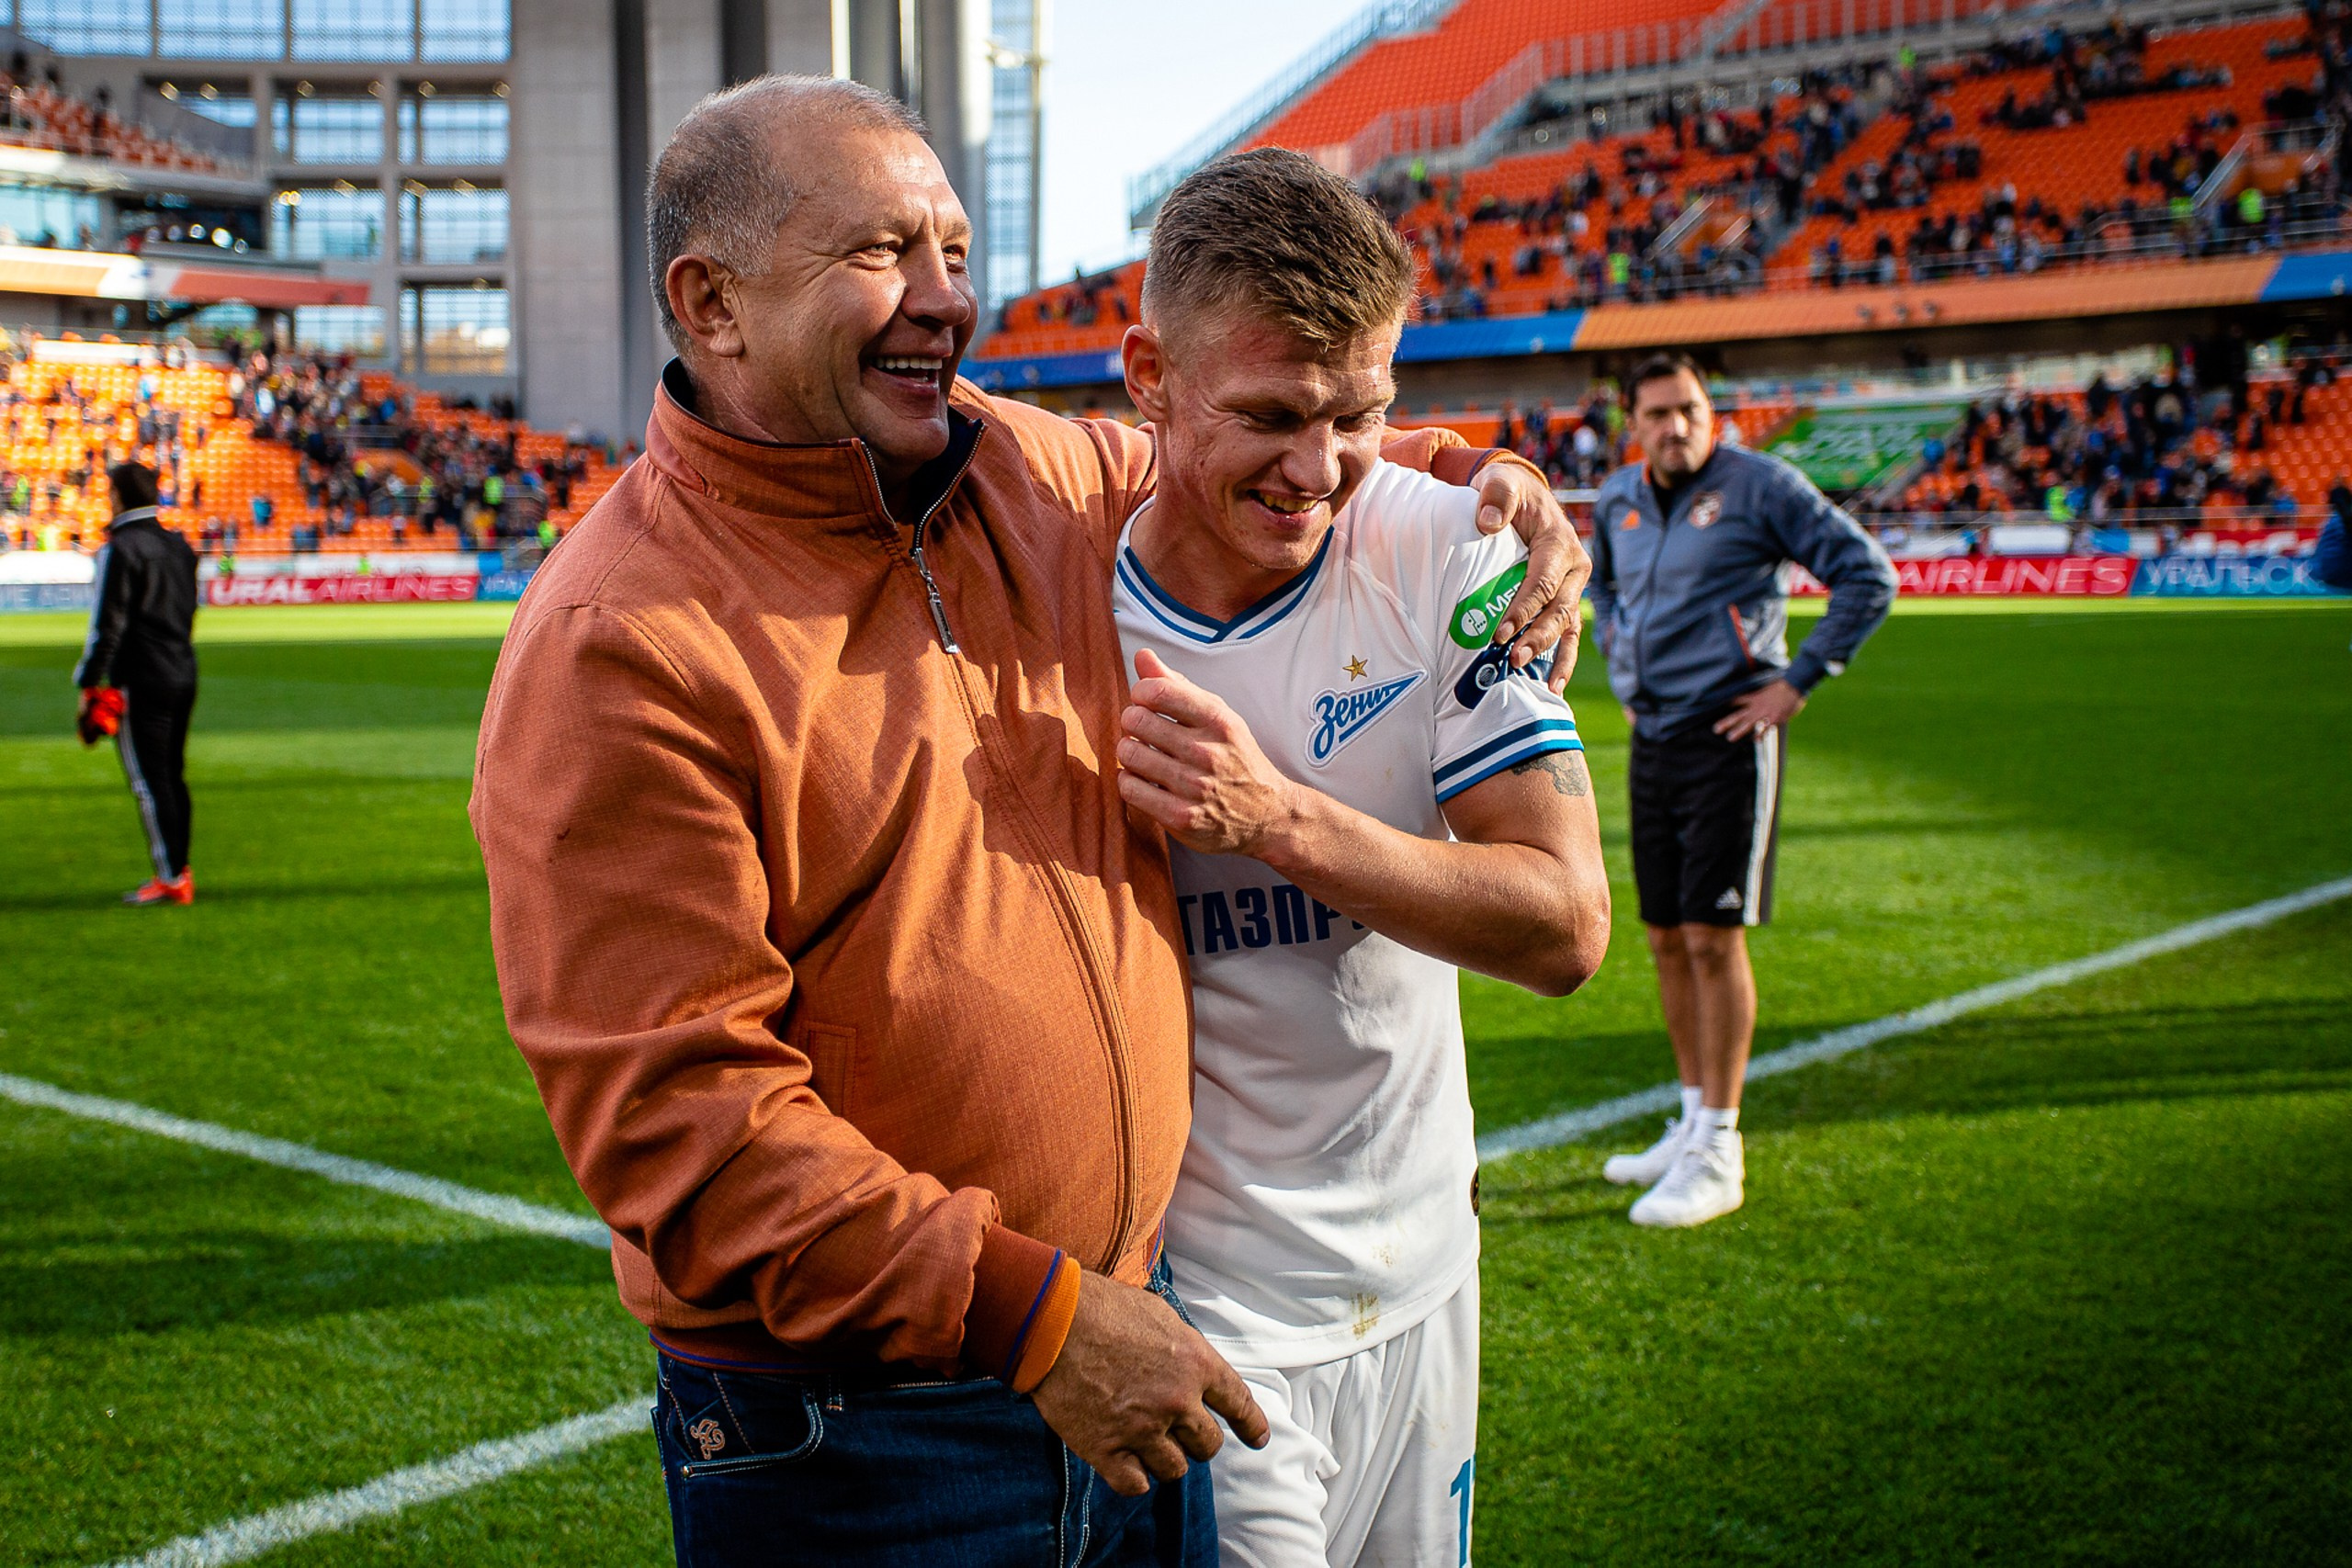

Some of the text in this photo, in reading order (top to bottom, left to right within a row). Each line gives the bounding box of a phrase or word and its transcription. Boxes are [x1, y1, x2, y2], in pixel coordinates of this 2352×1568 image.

[211, 577, 311, 604] URAL
[312, 576, 475, 603] AIRLINES
[1899, 558, 2128, 595] AIRLINES
[1176, 884, 1366, 956] ГАЗПР
